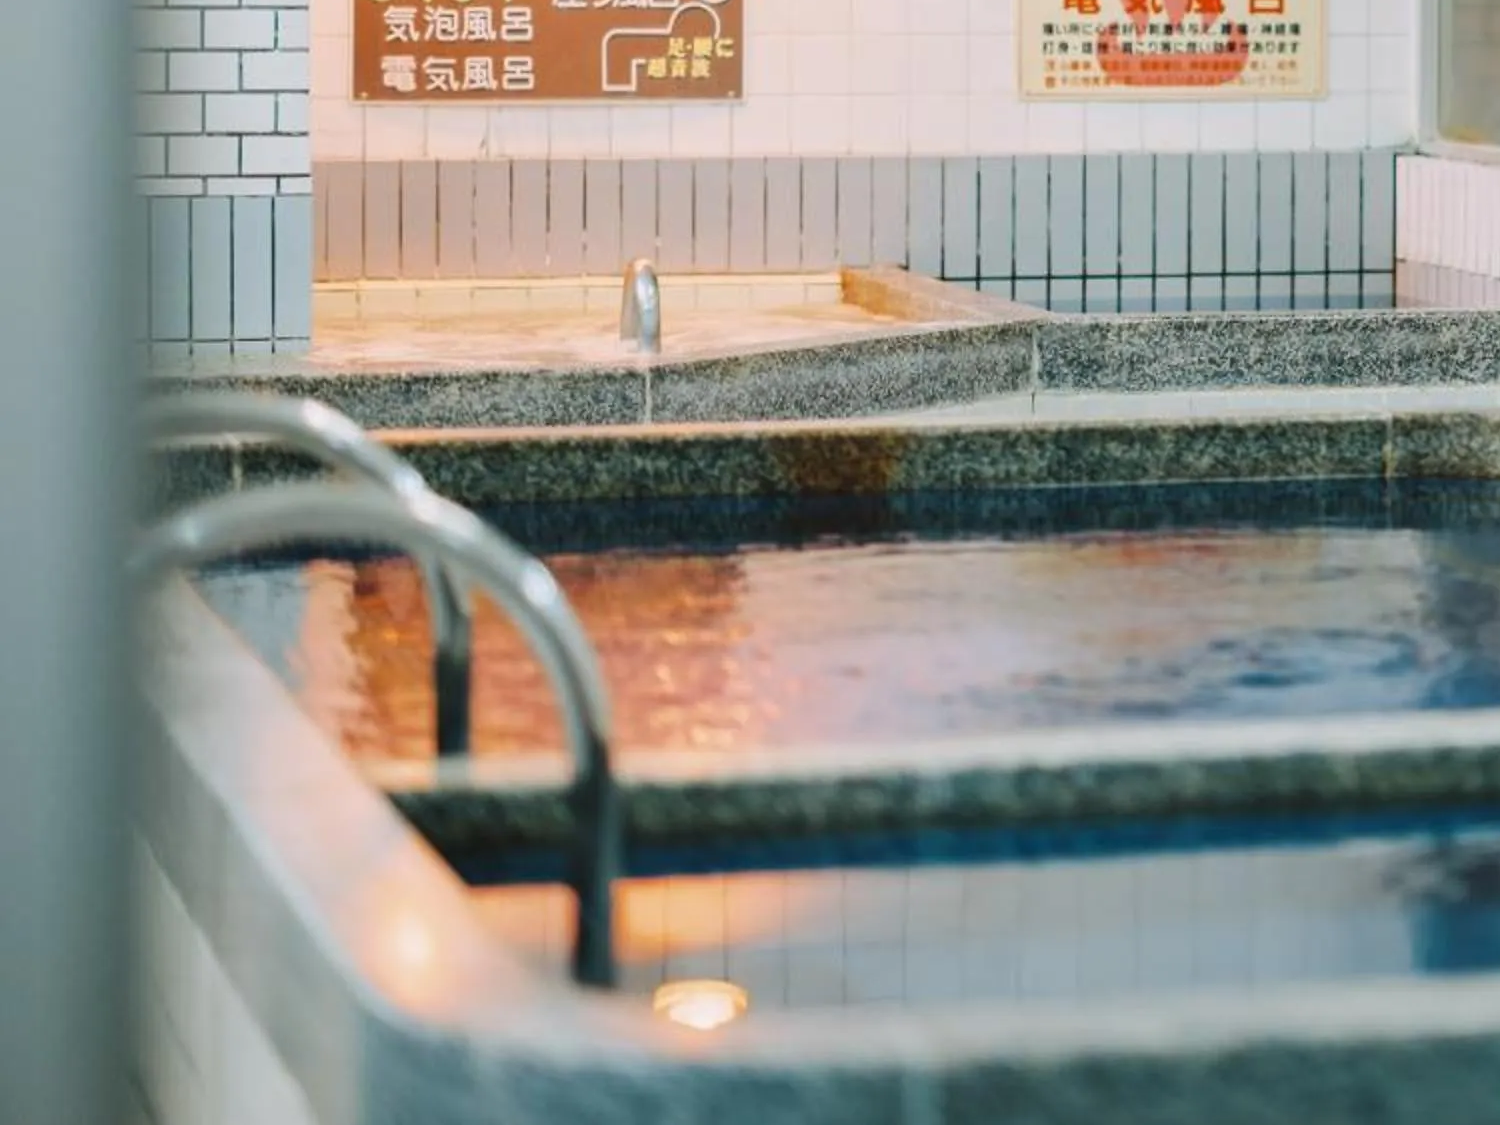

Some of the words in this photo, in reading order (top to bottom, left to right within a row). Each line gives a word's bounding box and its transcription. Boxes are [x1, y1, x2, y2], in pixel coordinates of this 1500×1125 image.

[383, 6, 534, 43] 気泡風呂
[380, 55, 535, 92] 電気風呂
